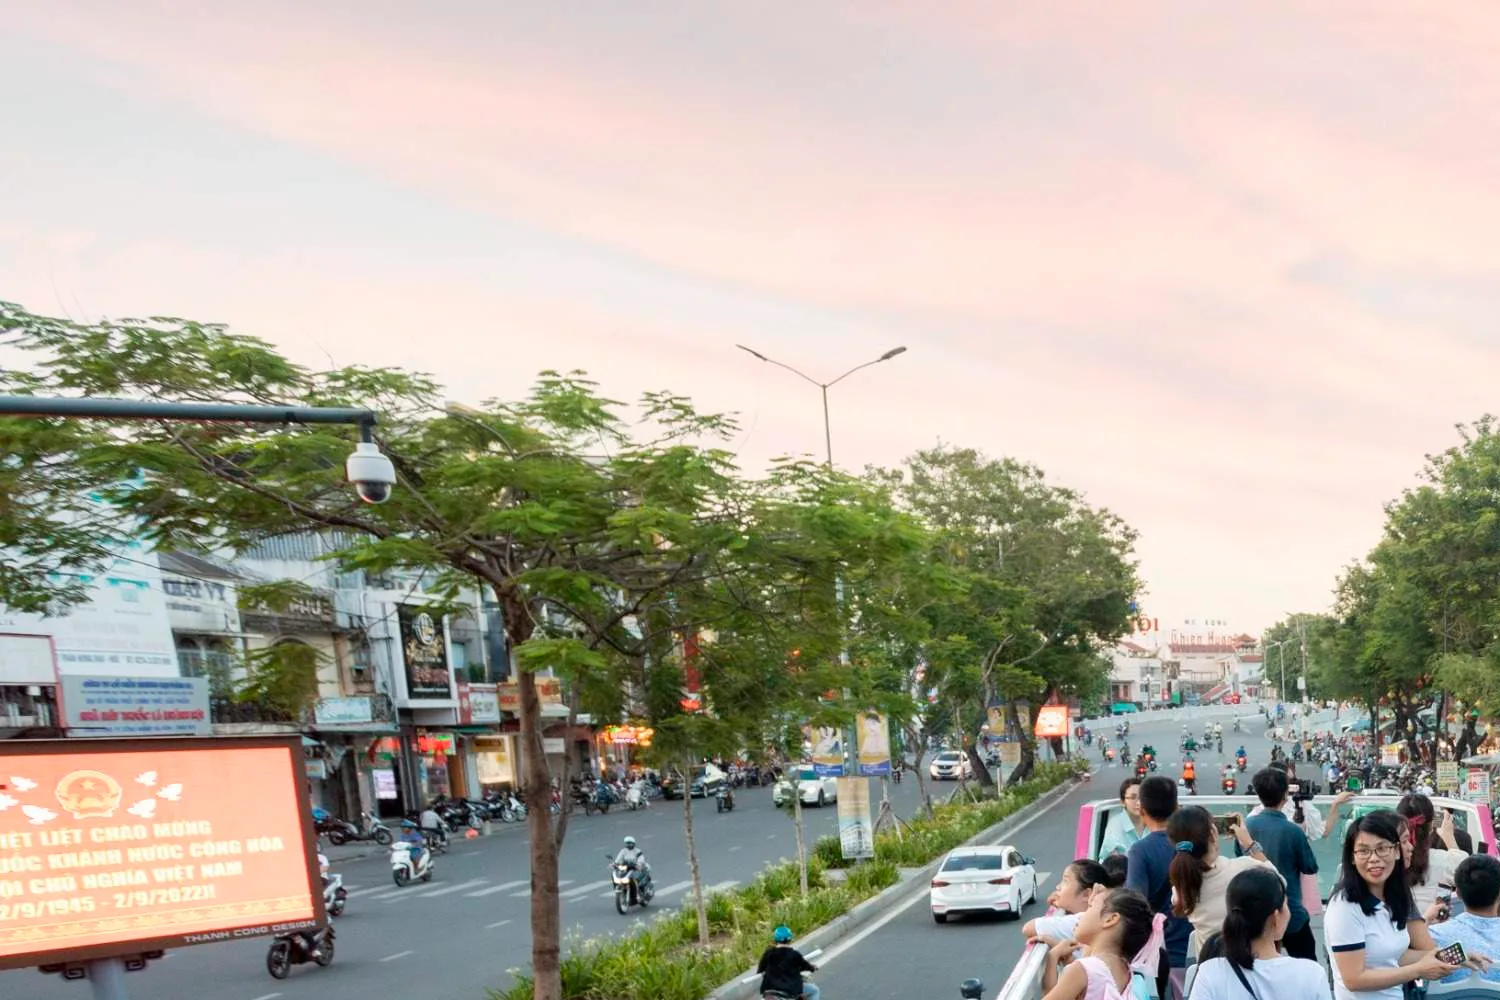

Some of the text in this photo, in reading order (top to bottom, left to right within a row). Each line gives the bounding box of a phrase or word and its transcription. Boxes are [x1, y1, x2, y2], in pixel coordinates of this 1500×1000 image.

[90, 824, 147, 844] CHÀO
[201, 860, 243, 877] NAM
[183, 931, 230, 943] THANH
[272, 919, 317, 933] DESIGN
